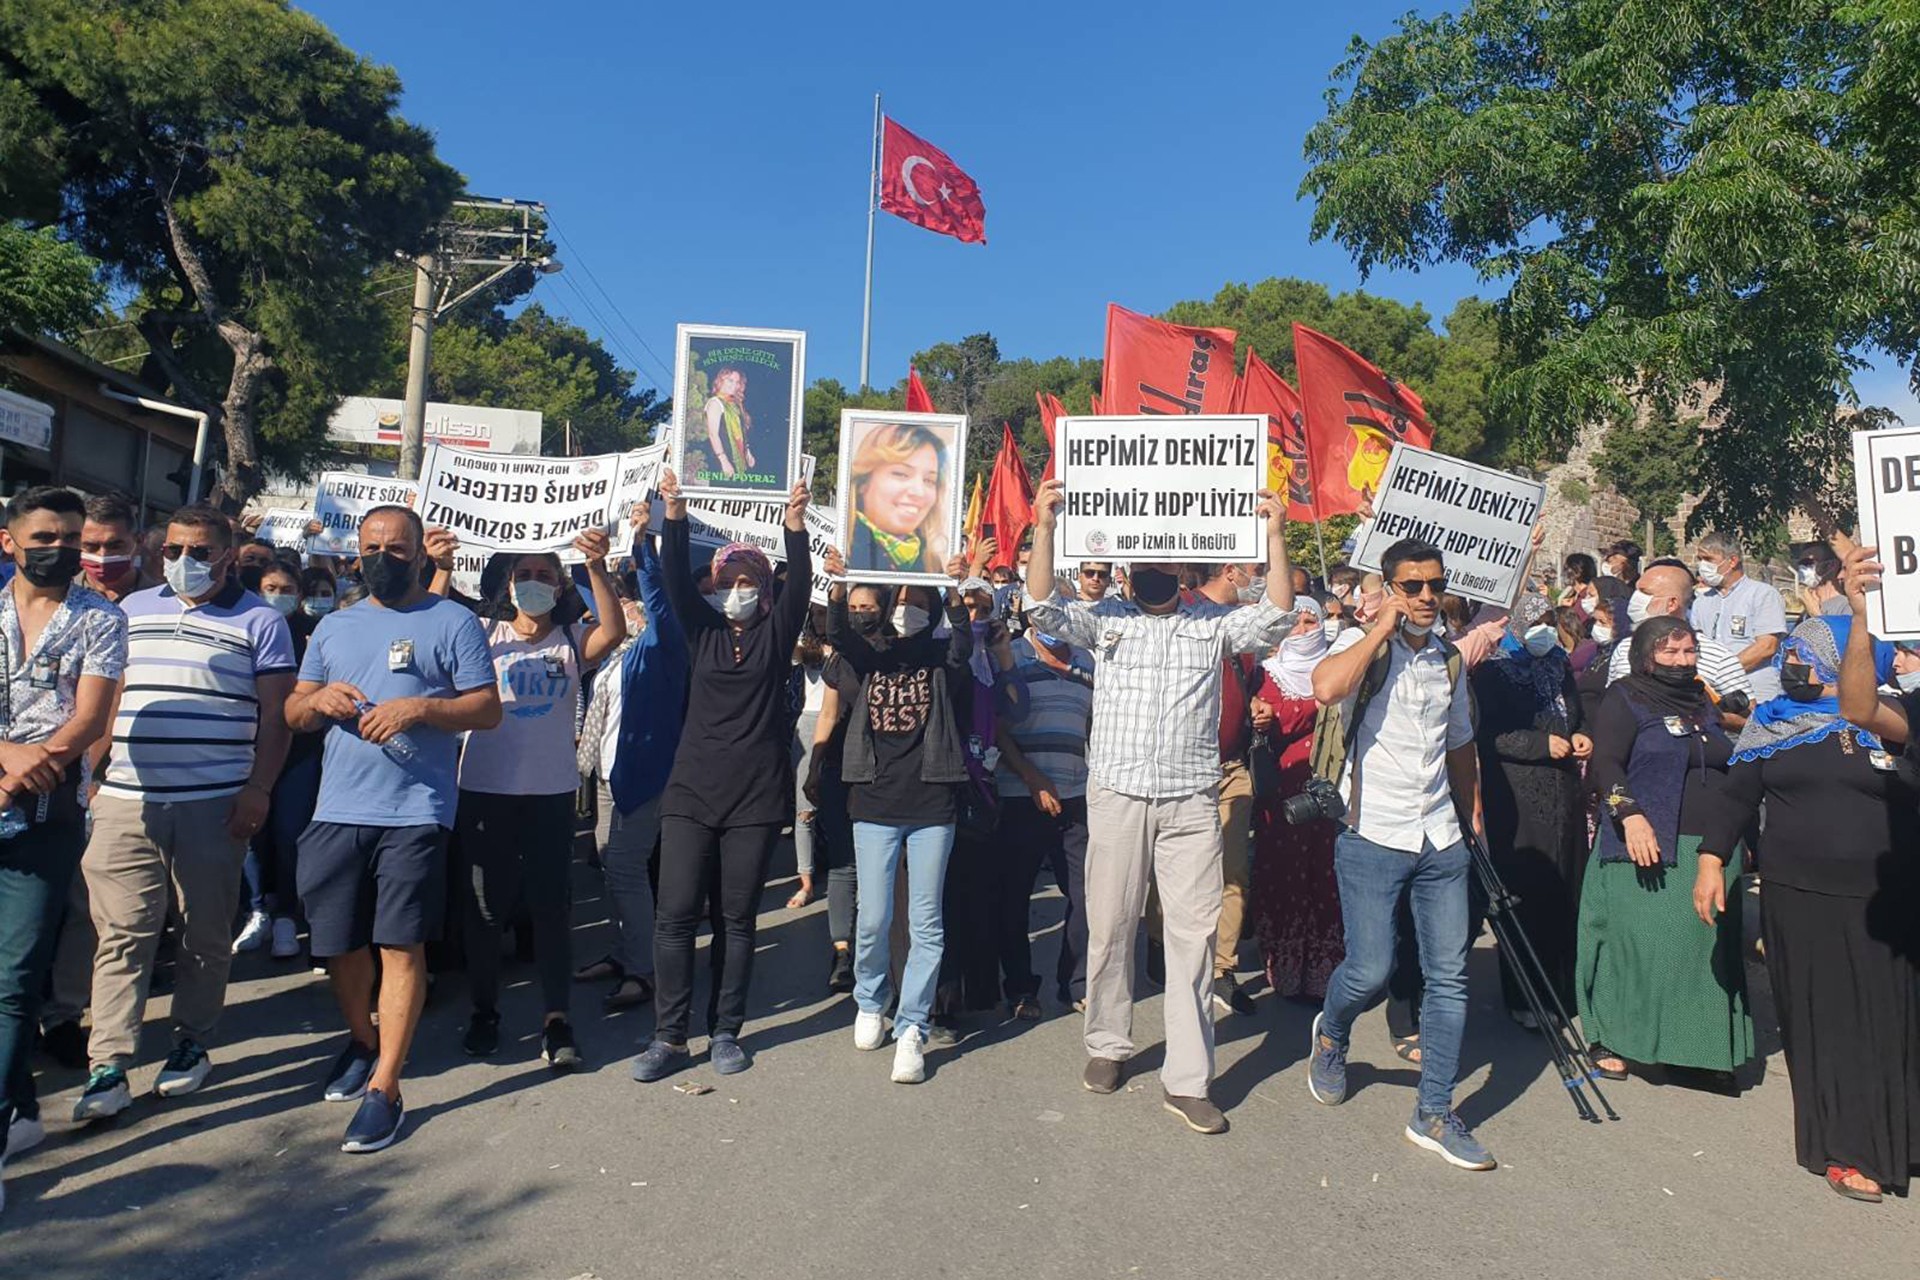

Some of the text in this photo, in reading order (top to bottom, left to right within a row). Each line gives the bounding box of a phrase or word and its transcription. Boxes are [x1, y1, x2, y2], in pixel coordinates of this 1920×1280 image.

[424, 416, 492, 438] olisan
[1068, 434, 1255, 466] HEPİMİZ DENİZ'İZ
[453, 456, 570, 475] HDP İZMİR İL ÖRGÜTÜ
[733, 473, 776, 484] POYRAZ
[326, 481, 376, 501] DENİZ'E
[438, 470, 608, 504] BARIŞ GELECEK!
[1392, 465, 1537, 527] HEPİMİZ DENİZ'İZ
[724, 499, 785, 527] HDP'LİYİ
[1068, 488, 1254, 517] HEPİMİZ HDP'LİYİZ!
[426, 501, 527, 543] SÖZÜMÜZ
[532, 508, 604, 541] DENİZ'E
[1117, 532, 1236, 551] HDP İZMİR İL ÖRGÜTÜ
[1375, 511, 1522, 569] HEPİMİZ HDP'LİYİZ!
[452, 553, 488, 572] EPİMİ
[1460, 571, 1498, 593] ÖRGÜTÜ
[869, 704, 930, 731] BEST
